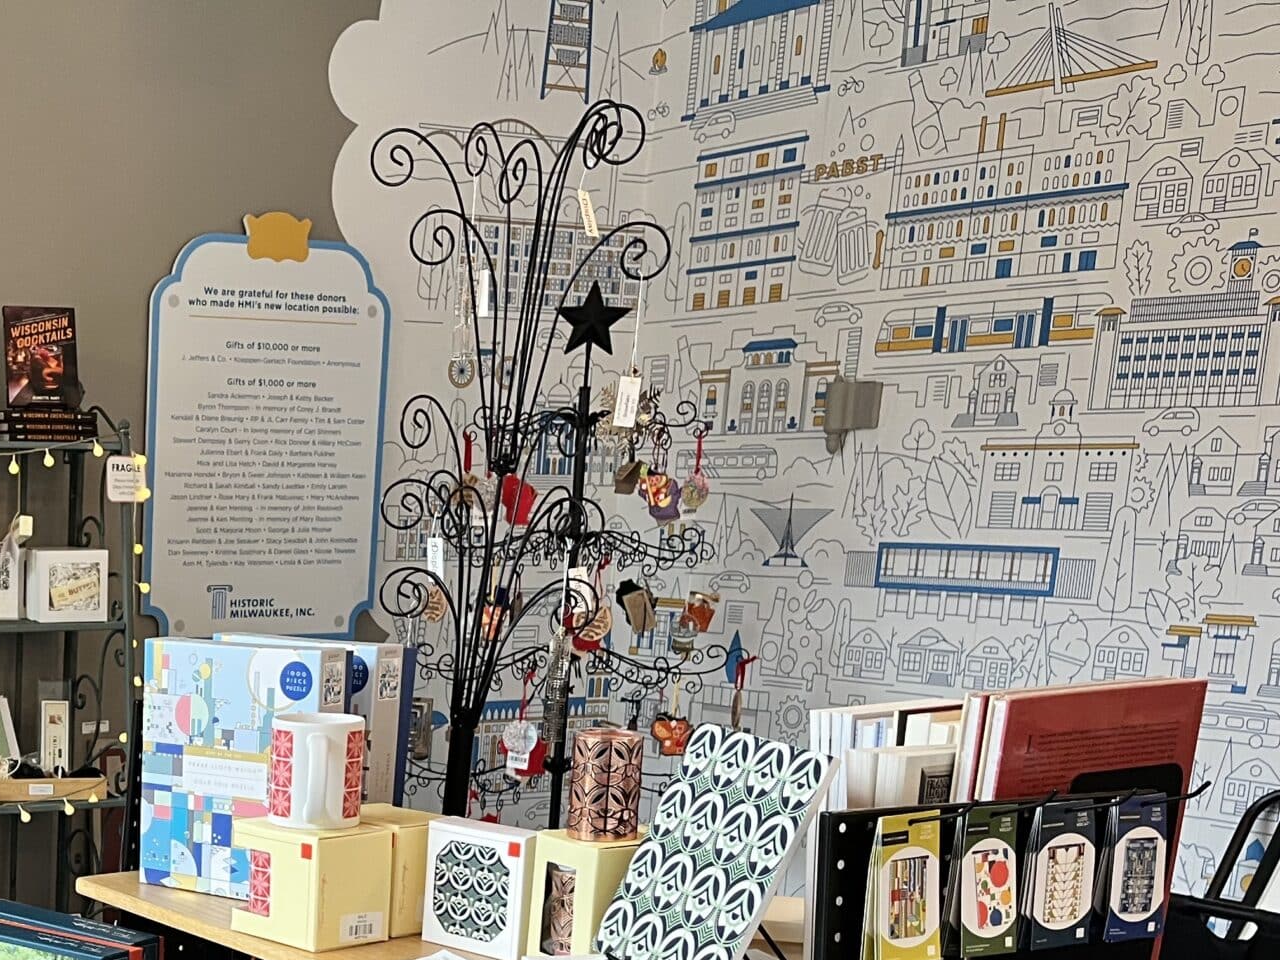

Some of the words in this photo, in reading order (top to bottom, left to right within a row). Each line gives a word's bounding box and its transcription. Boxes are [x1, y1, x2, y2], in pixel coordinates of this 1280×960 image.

[815, 154, 883, 181] PABST
[204, 287, 217, 296] We
[221, 289, 235, 297] are
[238, 289, 272, 299] grateful
[275, 290, 288, 299] for
[290, 291, 314, 300] these
[317, 292, 346, 302] donors
[189, 298, 208, 307] who
[209, 299, 233, 308] made
[238, 300, 261, 310] HMI's
[264, 303, 280, 311] new
[284, 303, 319, 313] location
[321, 304, 359, 316] possible:
[10, 317, 69, 338] WISCONSIN
[16, 328, 73, 349] COCKTAILS
[226, 341, 244, 350] Gifts
[246, 342, 255, 350] of
[257, 342, 288, 353] $10,000
[227, 378, 245, 387] Gifts
[247, 379, 256, 387] of
[258, 379, 284, 389] $1,000
[230, 599, 274, 607] HISTORIC
[230, 608, 293, 618] MILWAUKEE,
[296, 607, 315, 616] INC.
[286, 685, 307, 693] PUZZLE
